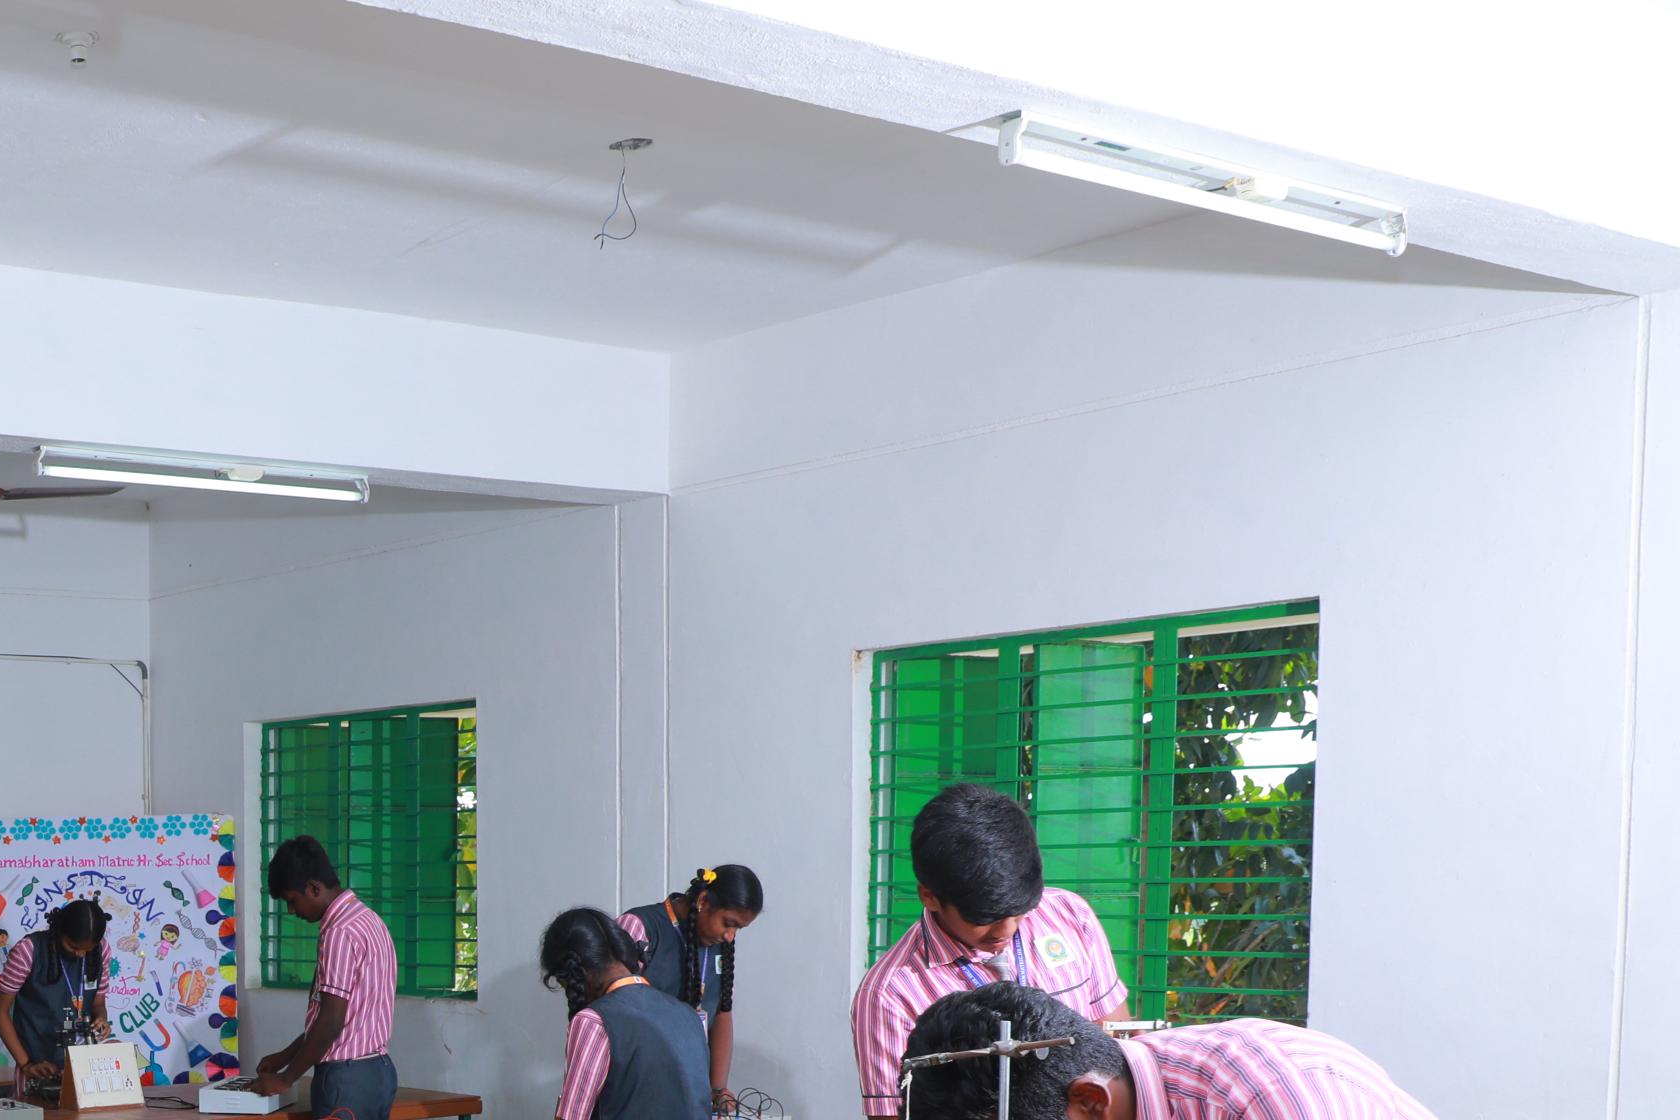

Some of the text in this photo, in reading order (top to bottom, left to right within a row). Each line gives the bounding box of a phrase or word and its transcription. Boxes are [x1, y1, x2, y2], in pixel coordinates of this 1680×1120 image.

[98, 855, 135, 868] Matric
[176, 851, 211, 868] School
[119, 993, 161, 1034] CLUB
